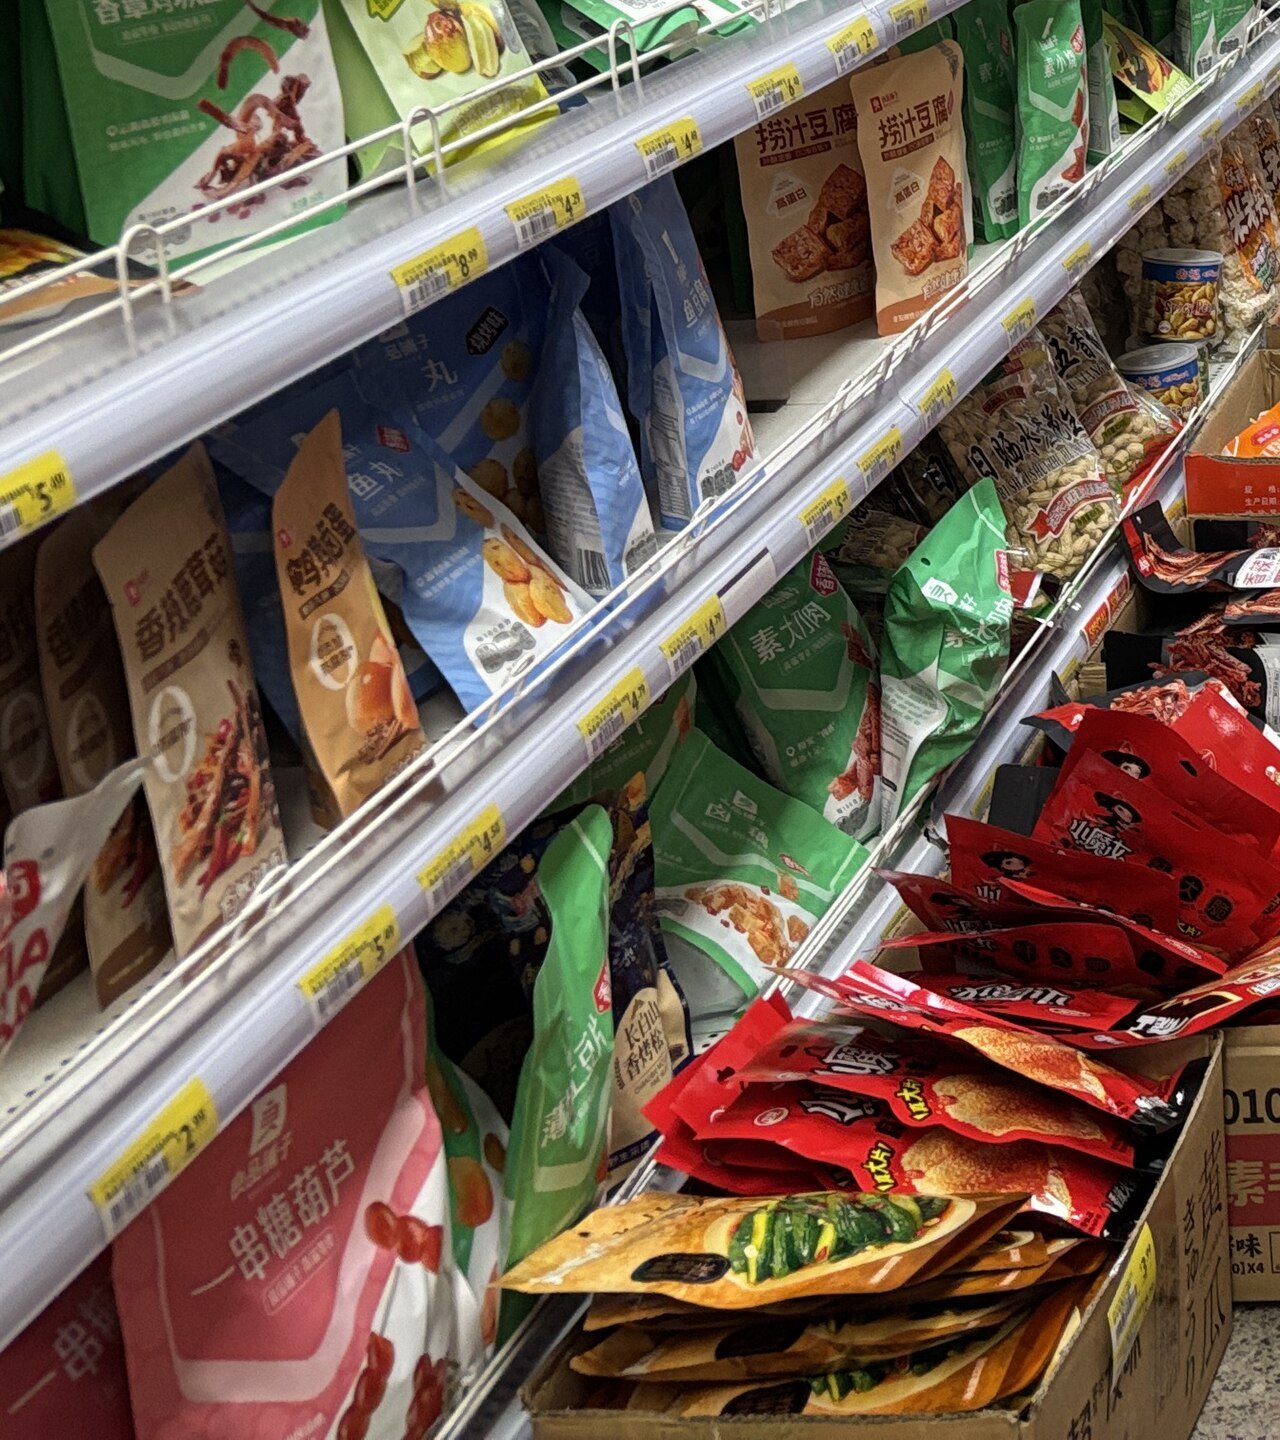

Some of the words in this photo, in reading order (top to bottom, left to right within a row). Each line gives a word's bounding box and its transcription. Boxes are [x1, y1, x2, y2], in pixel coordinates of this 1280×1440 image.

[877, 93, 950, 149] 捞汁豆腐
[775, 187, 808, 211] 高蛋白
[894, 181, 921, 205] 高蛋白
[190, 1139, 359, 1298] 一串糖葫芦
